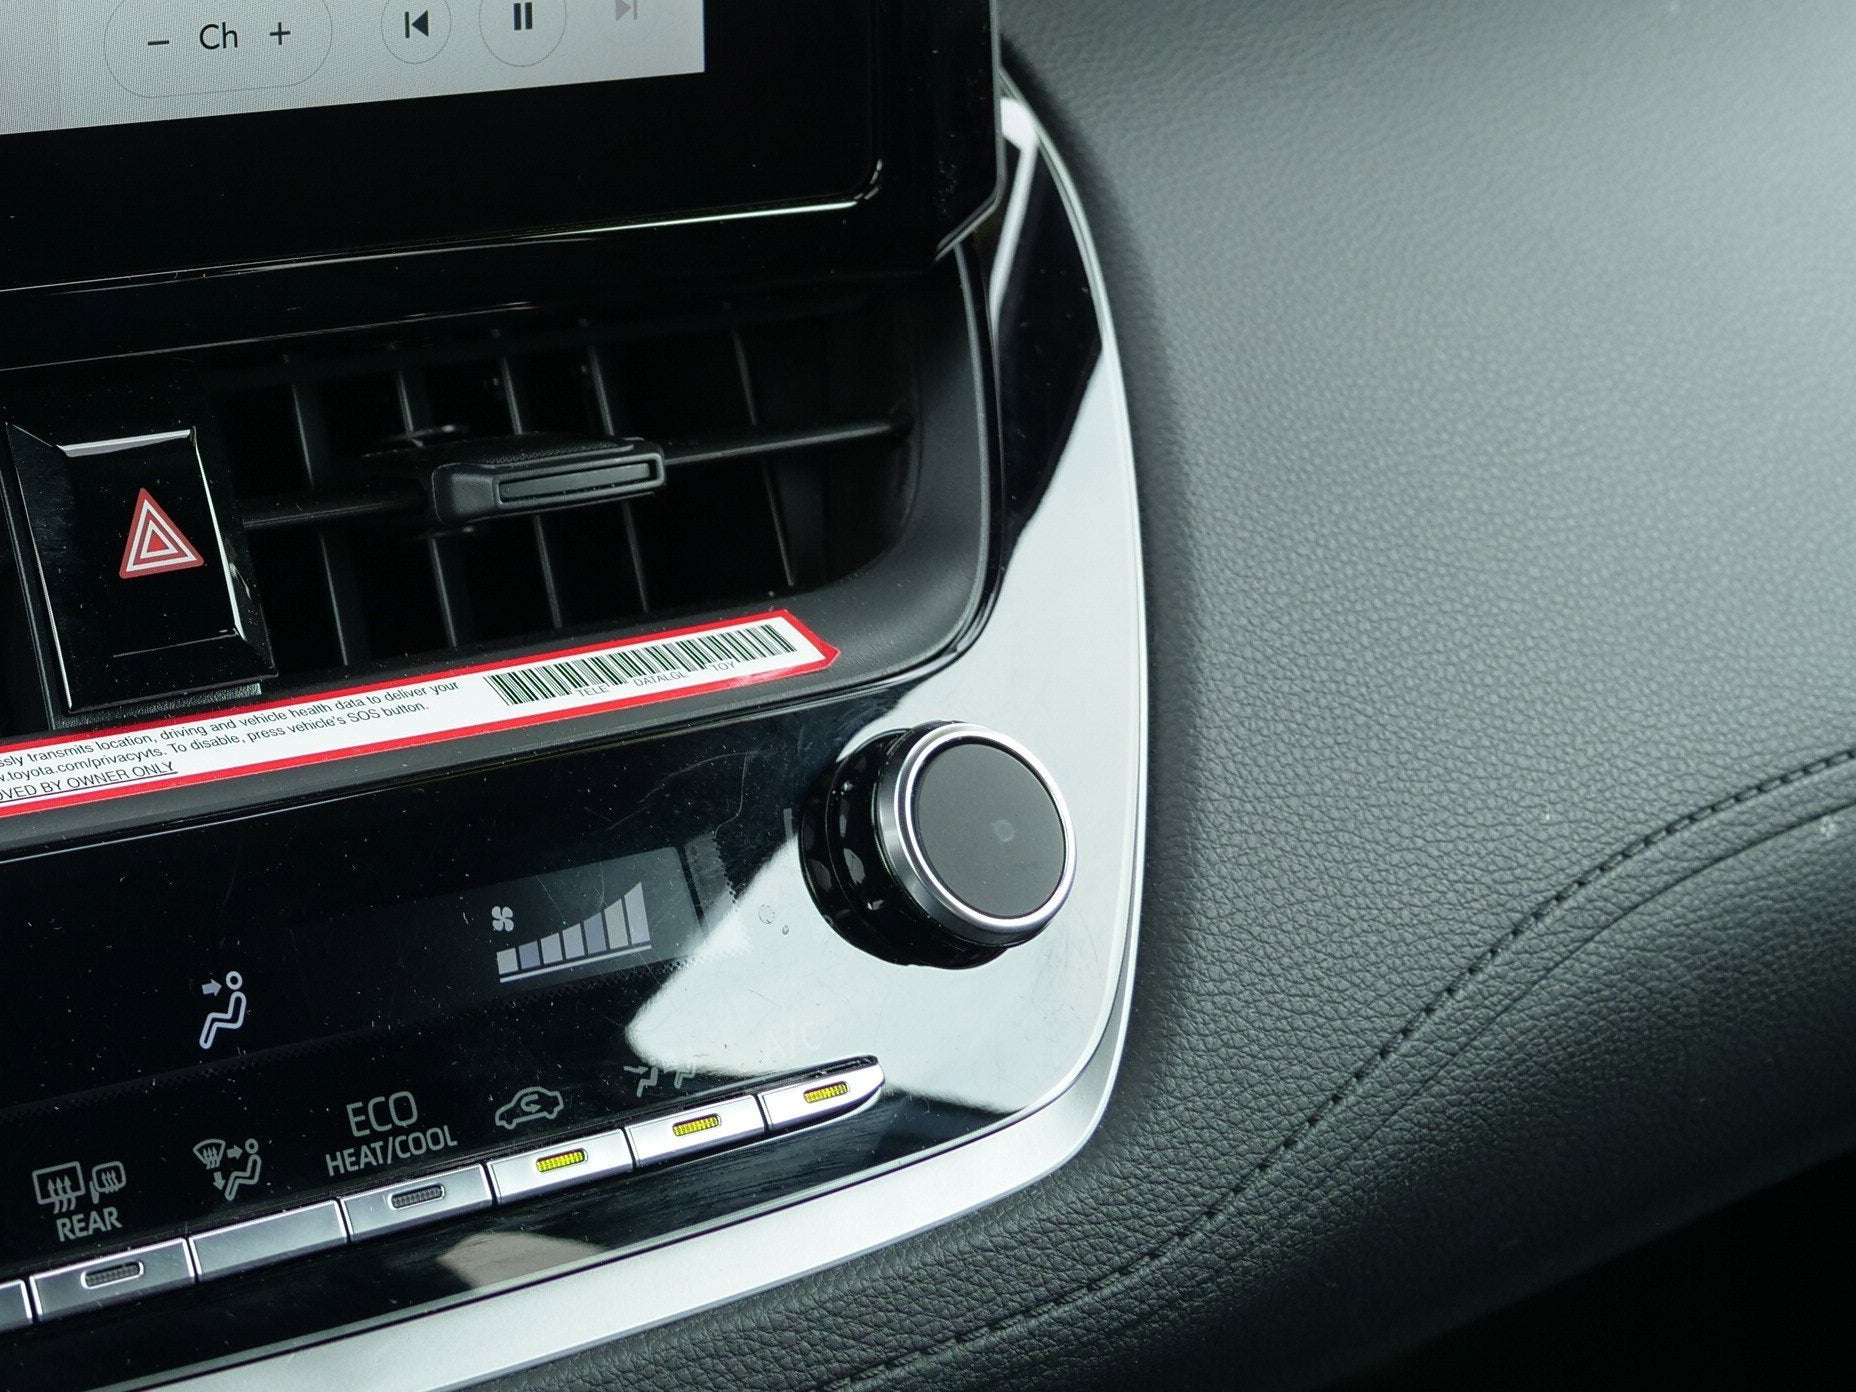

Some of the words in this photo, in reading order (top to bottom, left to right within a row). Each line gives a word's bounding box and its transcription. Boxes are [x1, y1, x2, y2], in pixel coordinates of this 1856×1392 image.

[199, 20, 239, 51] Ch
[574, 683, 609, 698] TELE
[708, 660, 736, 674] TOY
[28, 743, 95, 764] transmits
[95, 732, 157, 752] location,
[160, 722, 208, 741] driving
[209, 717, 237, 733] and
[239, 708, 288, 727] vehicle
[290, 701, 334, 719] health
[335, 696, 365, 712] data
[366, 694, 382, 706] to
[384, 684, 428, 703] deliver
[429, 682, 460, 697] your
[170, 742, 188, 755] To
[191, 734, 244, 752] disable,
[247, 726, 286, 744] press
[287, 714, 347, 734] vehicle's
[349, 708, 381, 723] SOS
[383, 701, 430, 718] button.
[40, 779, 62, 793] BY
[66, 767, 131, 791] OWNER
[132, 761, 175, 779] ONLY
[346, 1089, 420, 1138] ECO
[325, 1124, 458, 1178] HEAT/COOL
[56, 1207, 123, 1242] REAR
